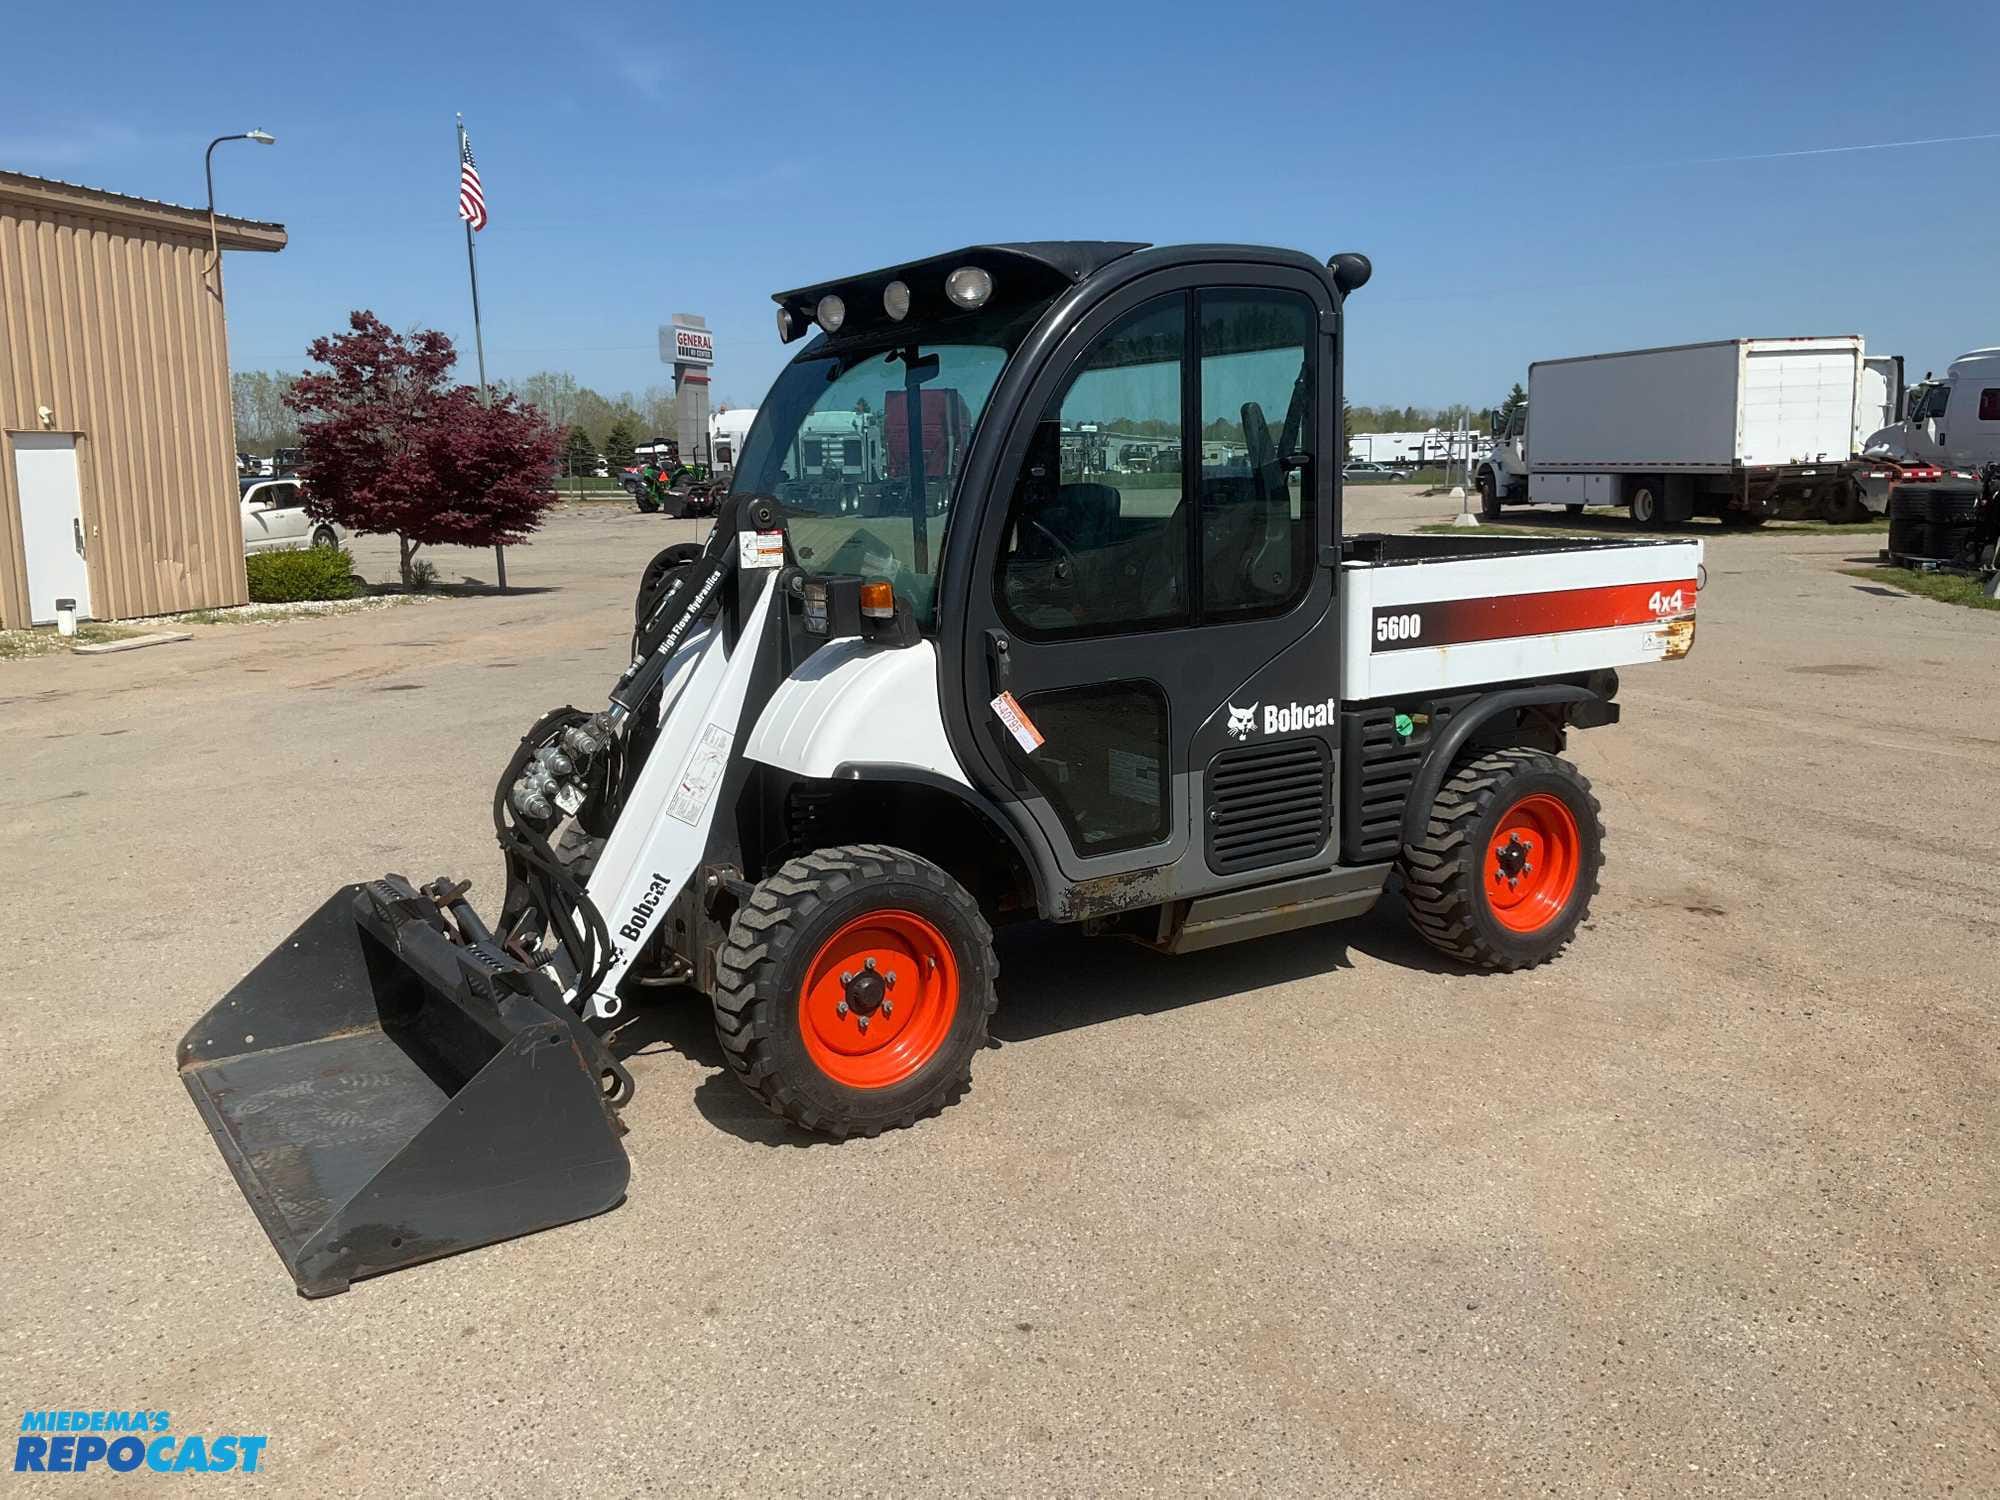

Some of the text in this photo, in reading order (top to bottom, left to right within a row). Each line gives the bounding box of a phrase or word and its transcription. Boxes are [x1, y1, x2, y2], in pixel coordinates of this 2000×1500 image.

[677, 332, 712, 348] GENERAL
[658, 570, 722, 655] High Flow Hydraulics
[1648, 588, 1683, 616] 4x4
[1376, 613, 1421, 641] 5600
[1263, 698, 1335, 735] Bobcat
[619, 873, 671, 942] Bobcat
